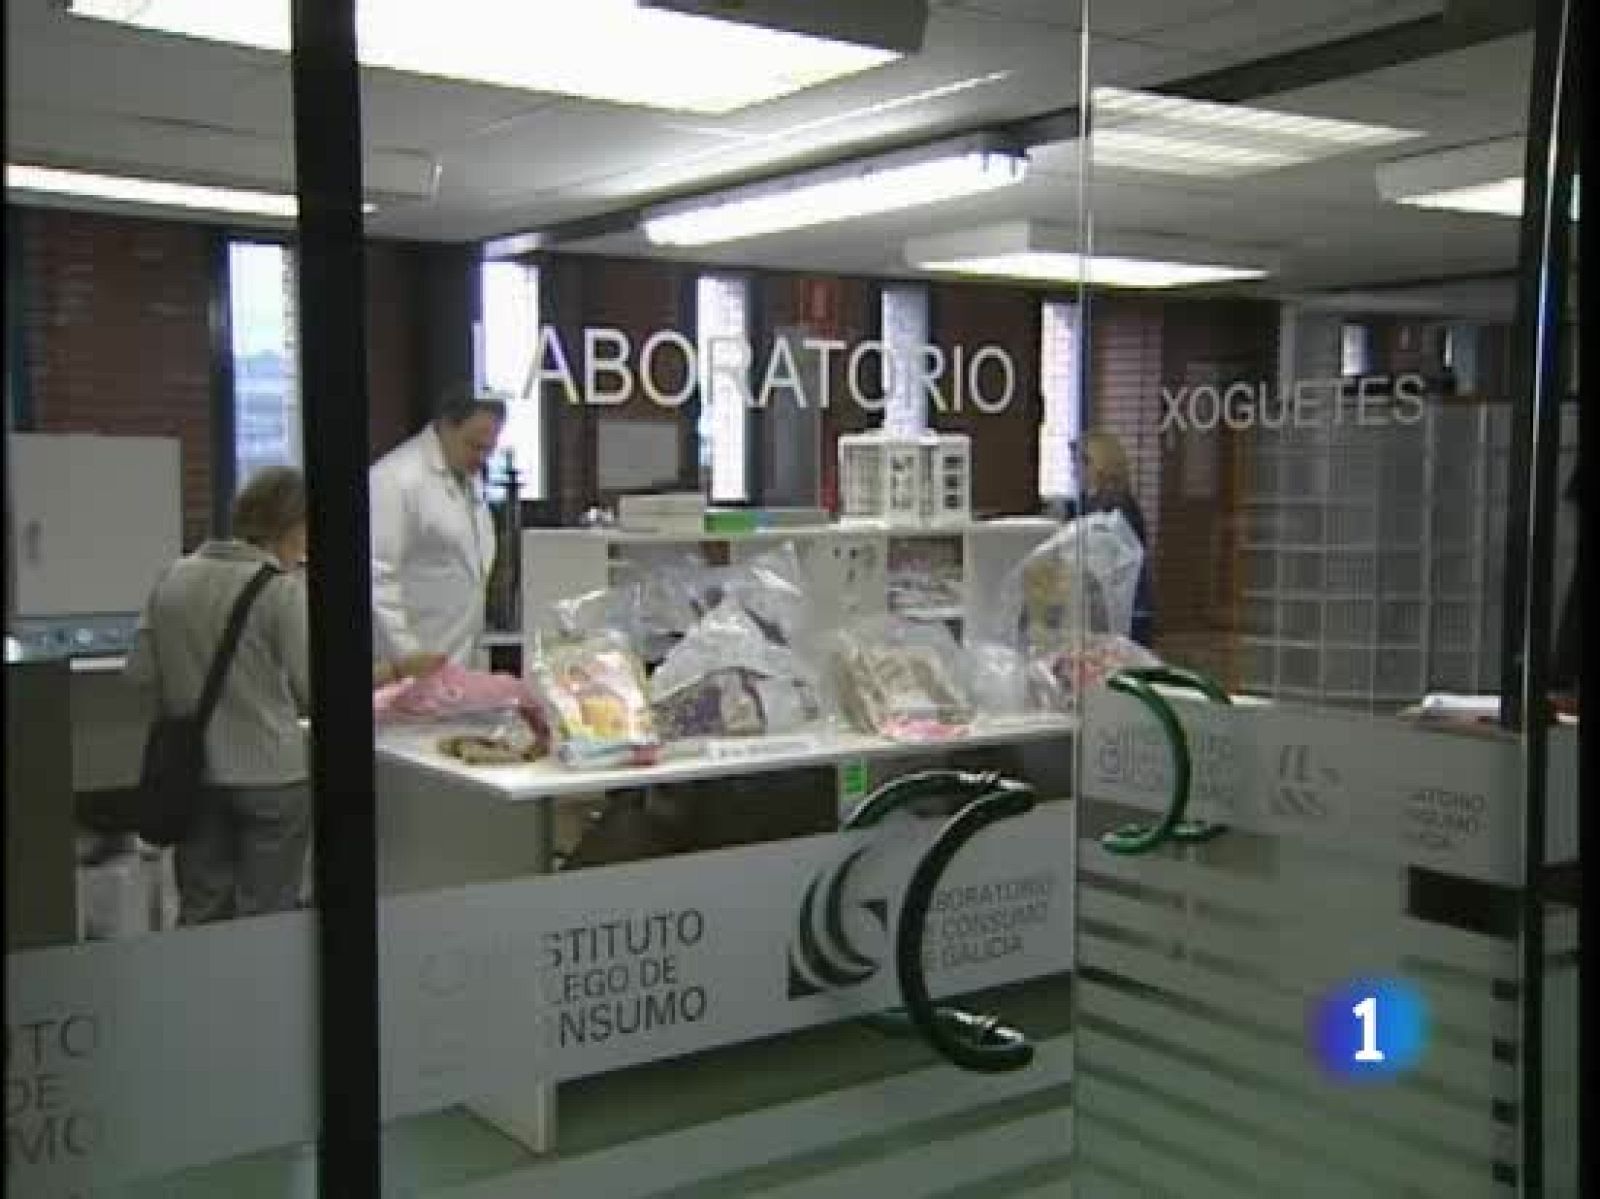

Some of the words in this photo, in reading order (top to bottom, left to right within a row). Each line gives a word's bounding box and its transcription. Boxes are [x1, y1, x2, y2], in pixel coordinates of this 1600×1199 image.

[470, 322, 1016, 413] LABORATORIO
[1160, 374, 1425, 432] XOGUETES
[640, 955, 678, 988] DE
